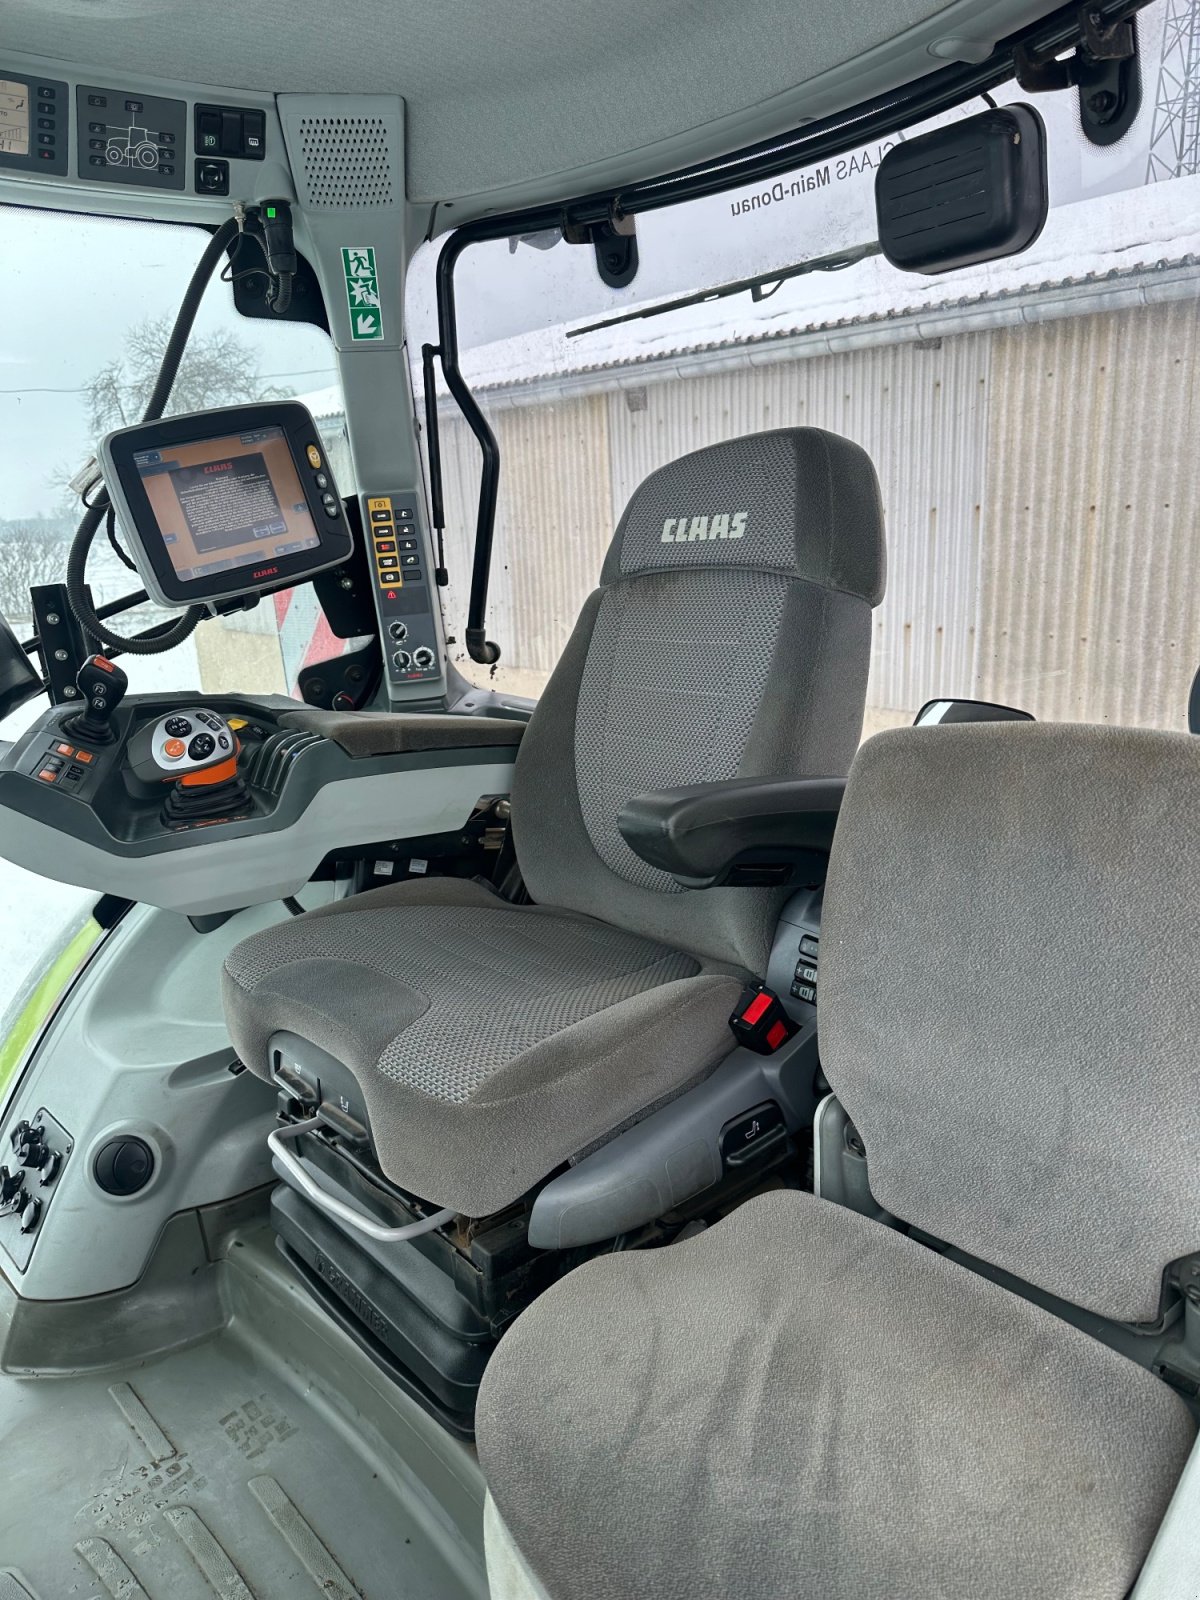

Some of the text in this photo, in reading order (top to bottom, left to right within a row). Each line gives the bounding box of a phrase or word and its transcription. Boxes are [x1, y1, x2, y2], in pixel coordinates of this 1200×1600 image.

[660, 511, 748, 543] CLAAS
[253, 567, 278, 579] CLAAS
[94, 685, 104, 694] F3
[94, 699, 103, 708] F4
